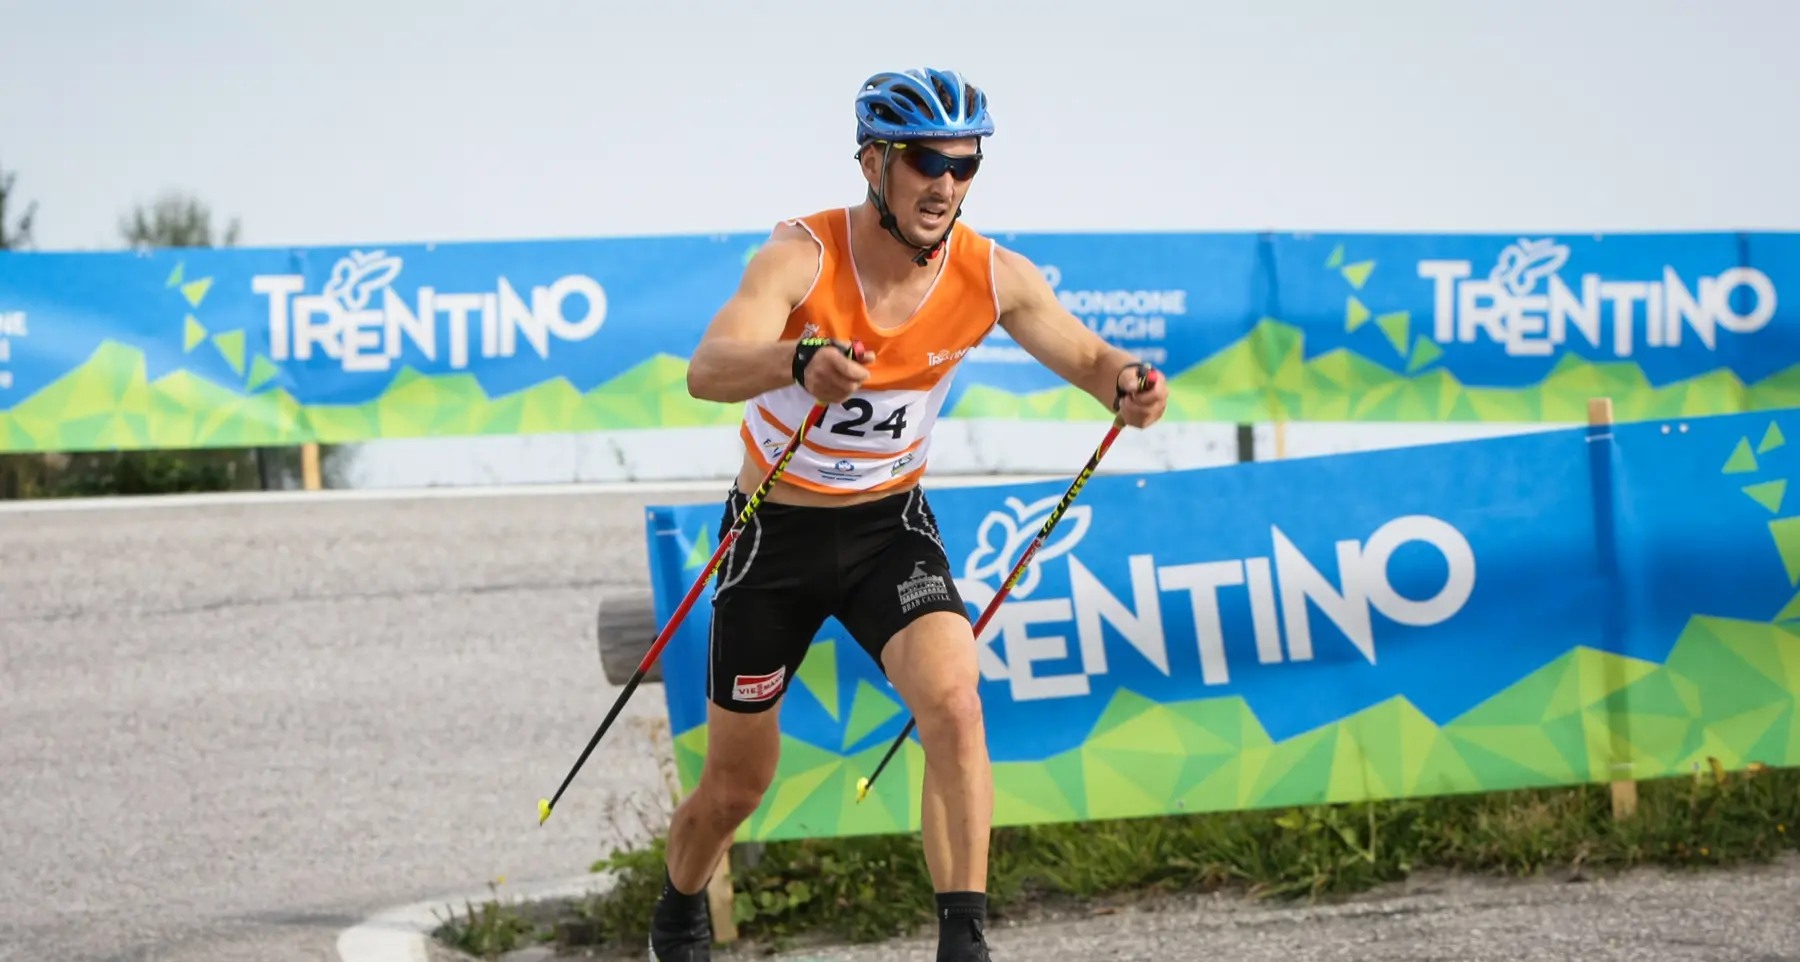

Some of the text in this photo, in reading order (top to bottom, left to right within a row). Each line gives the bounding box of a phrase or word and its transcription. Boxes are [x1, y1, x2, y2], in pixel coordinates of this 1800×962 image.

[252, 274, 608, 372] TRENTINO
[1417, 259, 1778, 356] TRENTINO
[902, 594, 952, 614] BRAN CASTLE
[953, 514, 1477, 702] RENTINO
